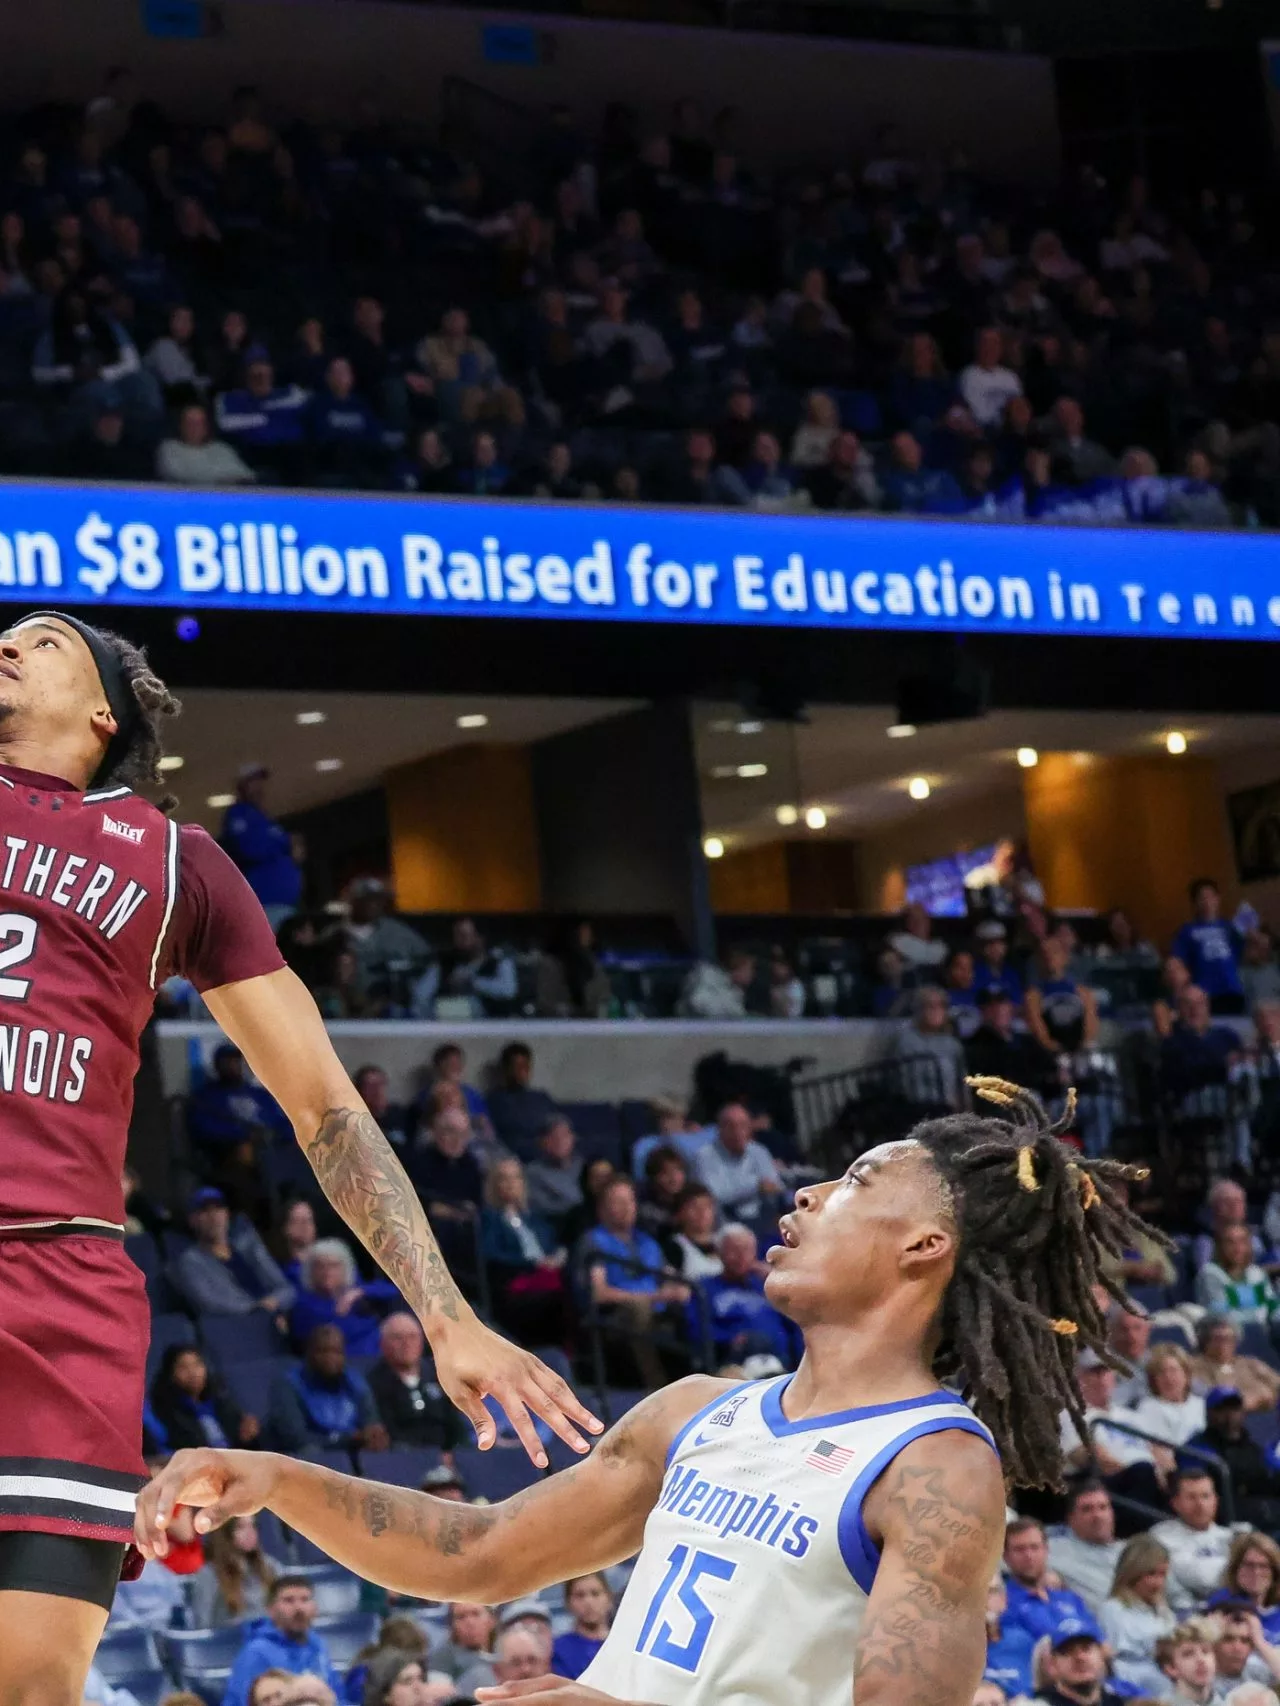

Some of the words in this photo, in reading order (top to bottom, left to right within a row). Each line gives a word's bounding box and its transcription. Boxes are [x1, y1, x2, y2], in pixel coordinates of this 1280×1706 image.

[76, 511, 164, 594] $8
[175, 522, 390, 598] Billion
[402, 533, 615, 605] Raised
[627, 542, 717, 609] for
[733, 553, 1034, 620] Education
[1047, 569, 1101, 622] in
[656, 1465, 819, 1559] Memphis
[634, 1544, 738, 1674] 15
